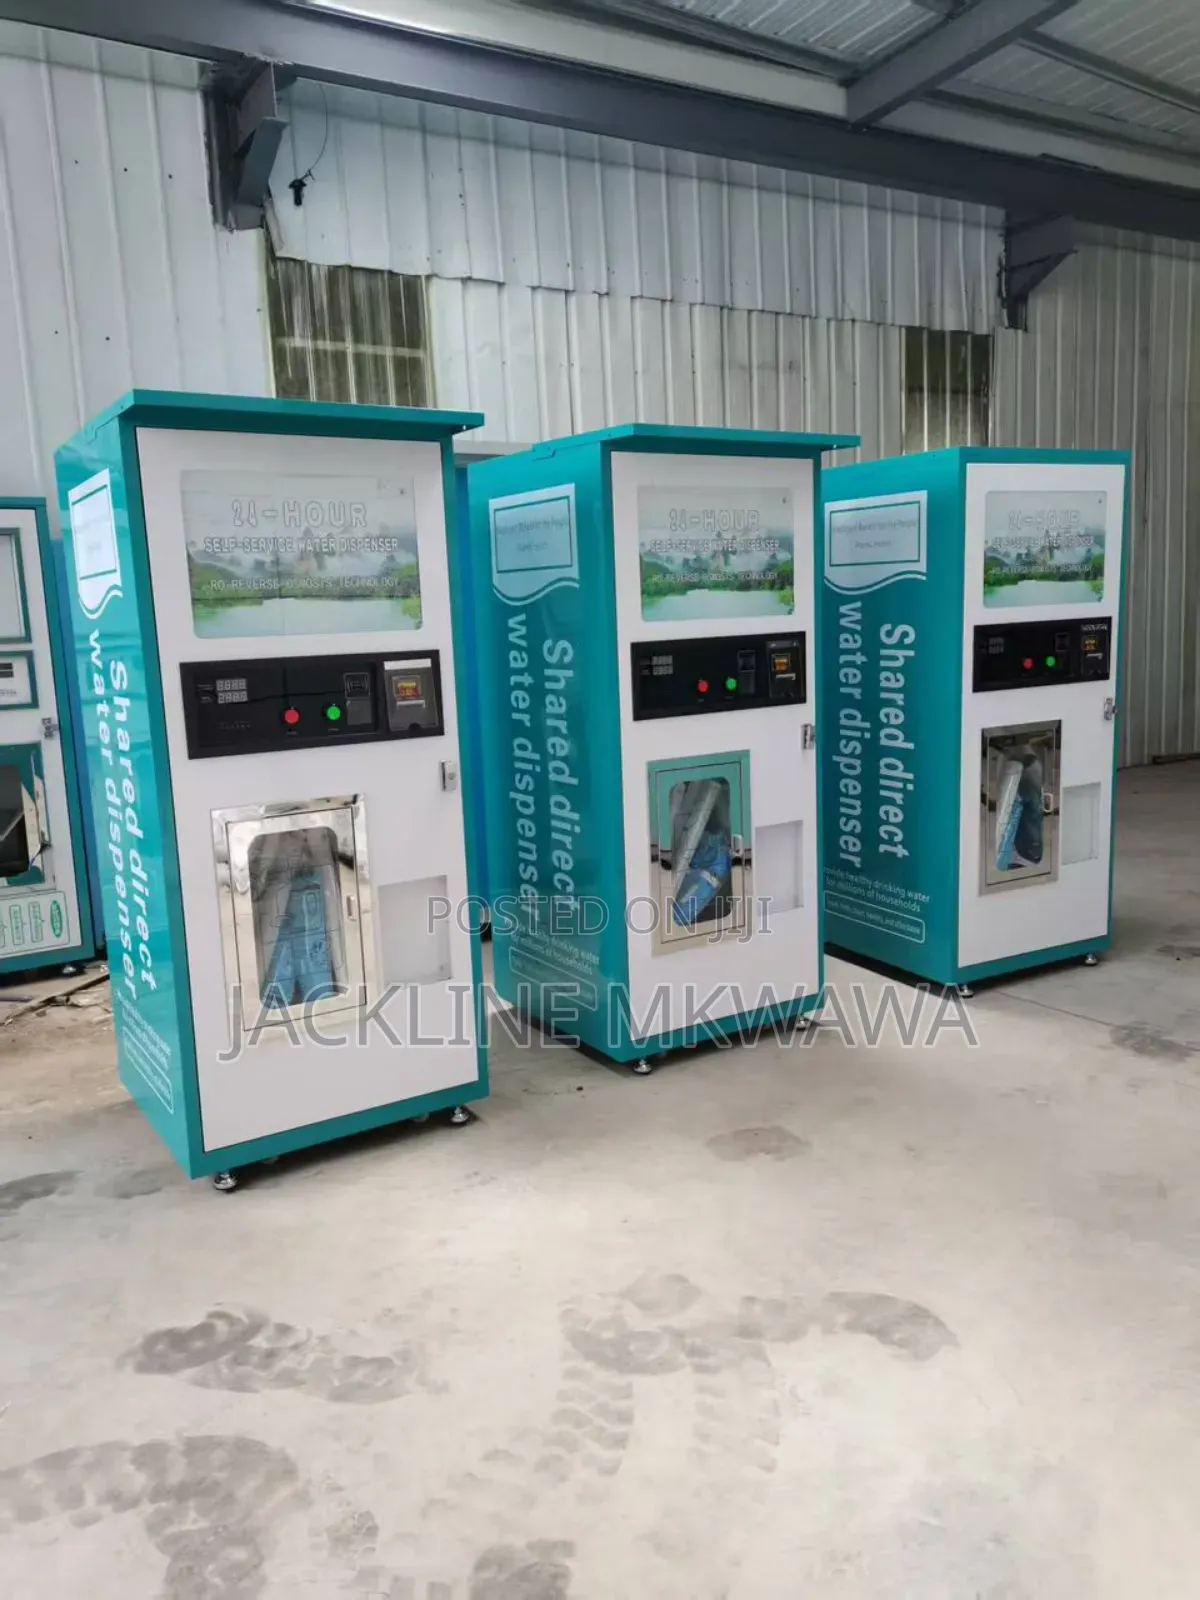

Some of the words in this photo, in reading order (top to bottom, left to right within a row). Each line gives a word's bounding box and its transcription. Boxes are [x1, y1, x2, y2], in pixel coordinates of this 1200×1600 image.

[507, 613, 535, 727] water
[542, 638, 579, 786] Shared
[838, 601, 869, 700] water
[879, 623, 916, 750] Shared
[89, 628, 114, 766] water
[105, 777, 137, 1000] dispenser
[109, 659, 144, 839] Shared
[129, 848, 157, 991] direct
[509, 736, 541, 921] dispenser
[549, 794, 581, 912] direct
[832, 708, 871, 868] dispenser
[878, 757, 915, 858] direct
